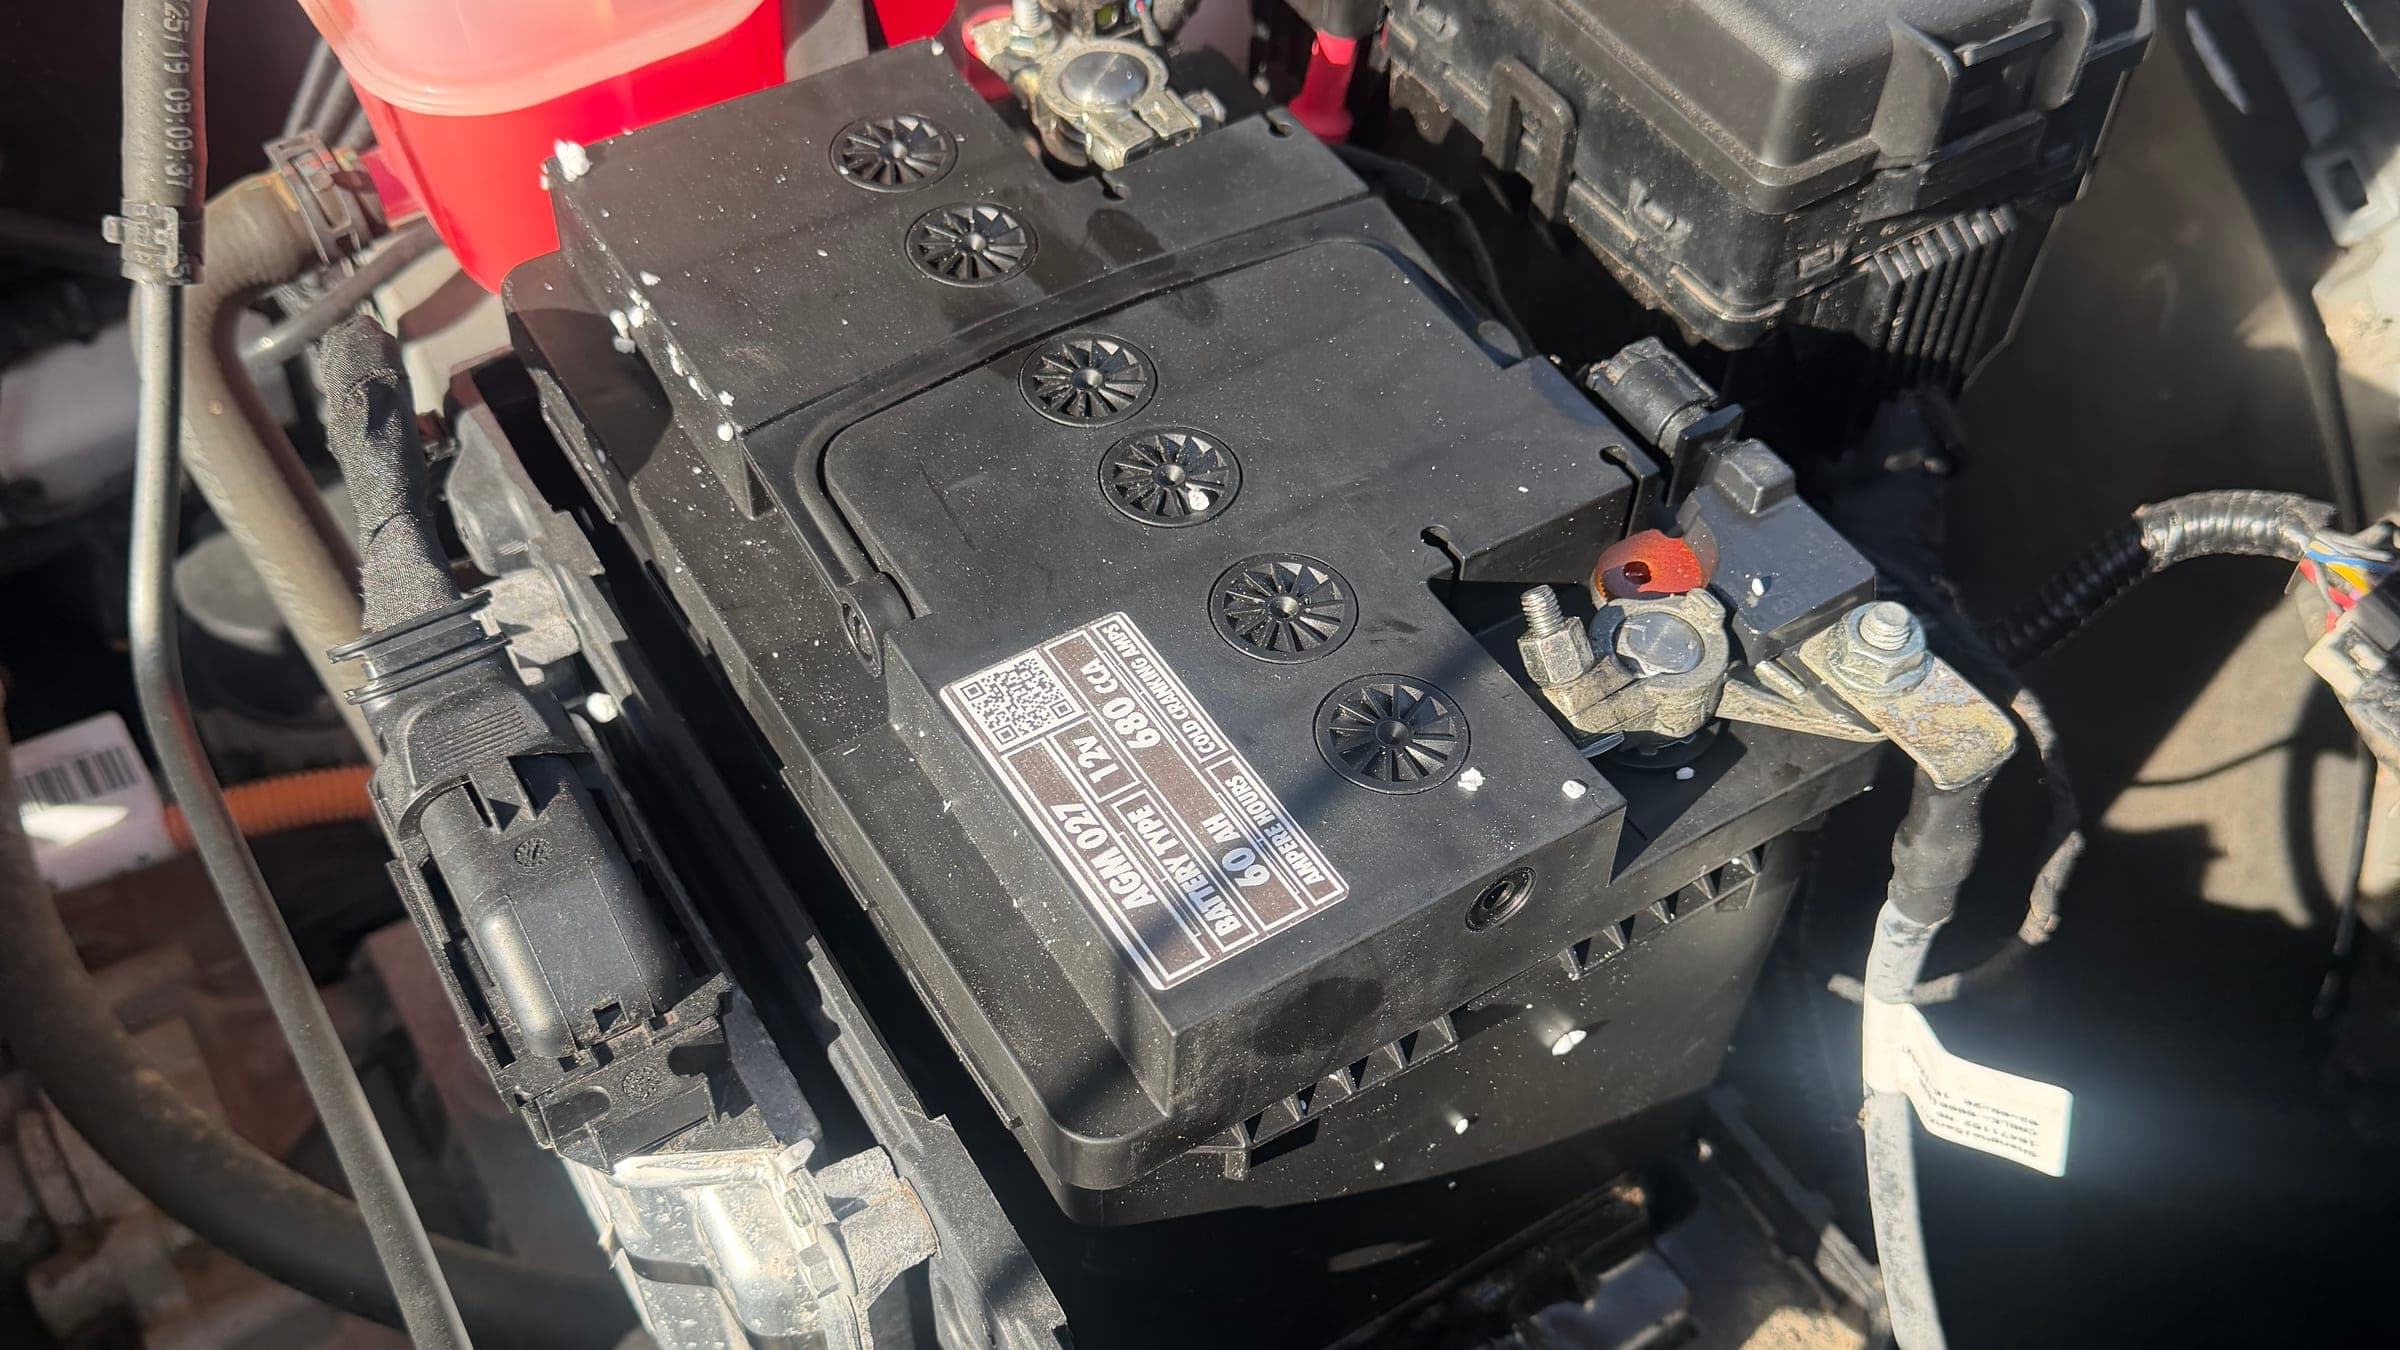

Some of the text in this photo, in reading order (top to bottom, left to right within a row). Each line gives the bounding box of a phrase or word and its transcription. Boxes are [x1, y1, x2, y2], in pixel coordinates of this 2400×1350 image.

[1079, 658, 1161, 749] 680 CCA
[1101, 624, 1216, 754] COLD CRANKING AMPS
[1050, 802, 1157, 911] AGM 027
[1127, 805, 1242, 937] BATTERY TYPE
[1200, 814, 1271, 889] 60 AH
[1225, 774, 1322, 885] AMPERE HOURS
